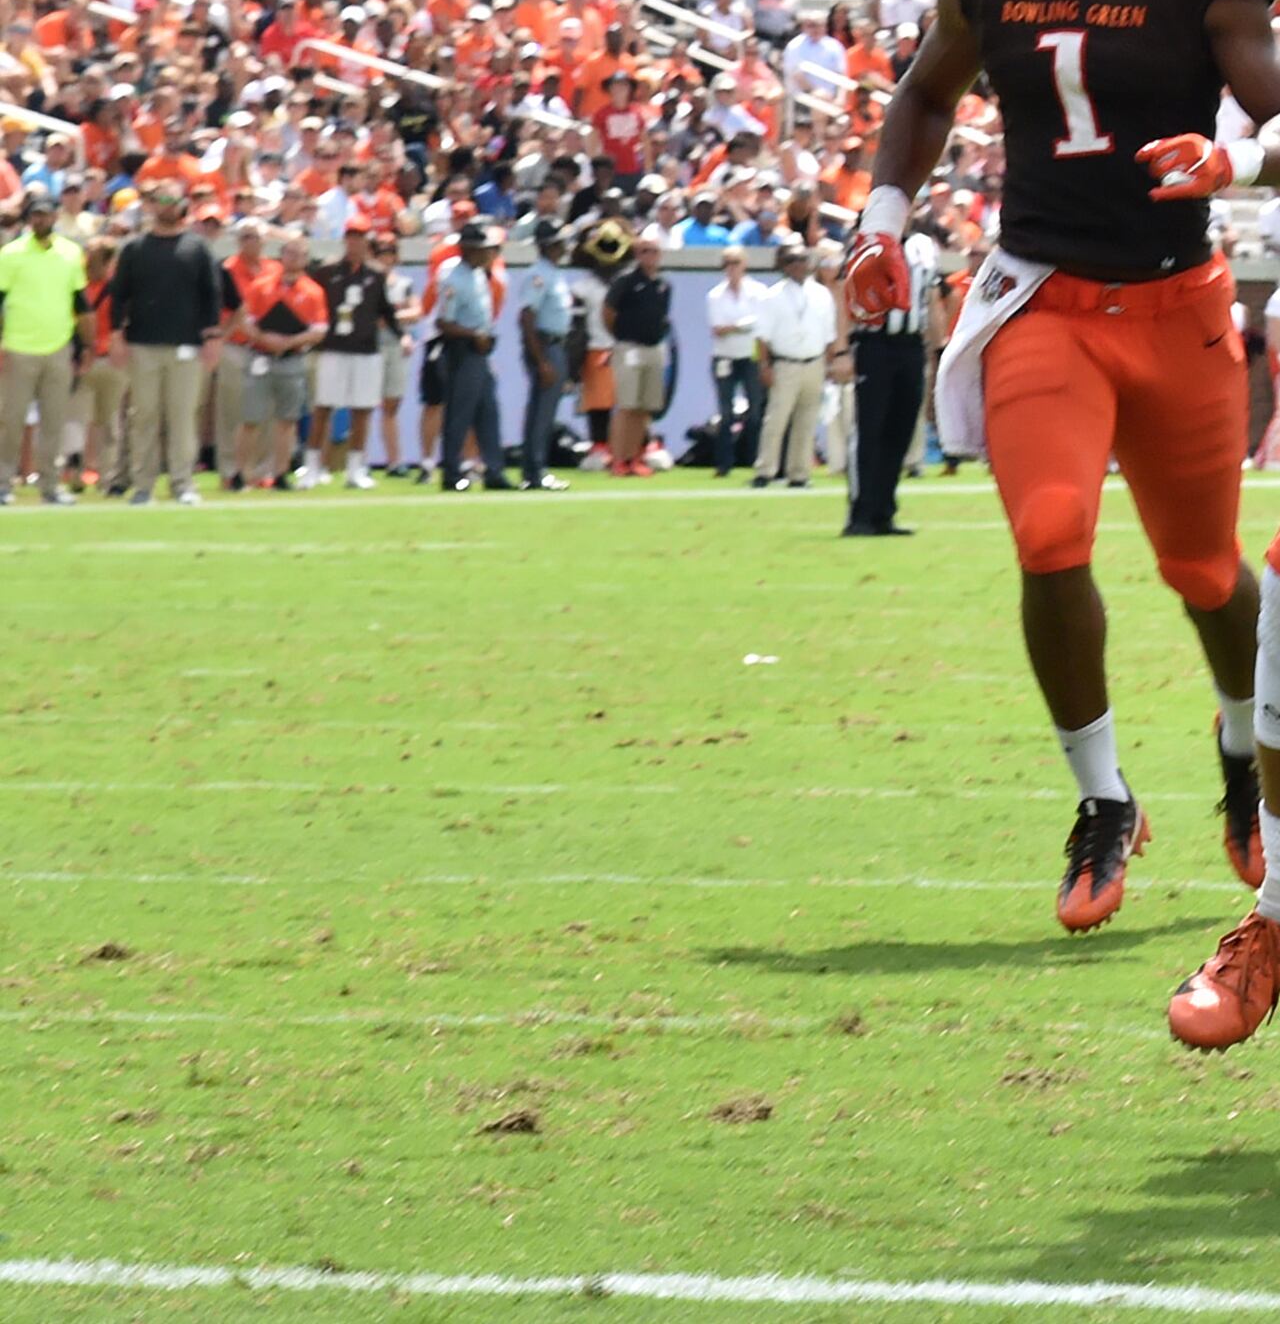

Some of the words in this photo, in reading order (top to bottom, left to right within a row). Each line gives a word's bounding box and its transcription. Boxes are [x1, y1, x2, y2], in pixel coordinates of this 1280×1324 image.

[1001, 0, 1080, 23] BOWLING
[1085, 3, 1148, 27] GREEN
[1034, 27, 1115, 158] 1
